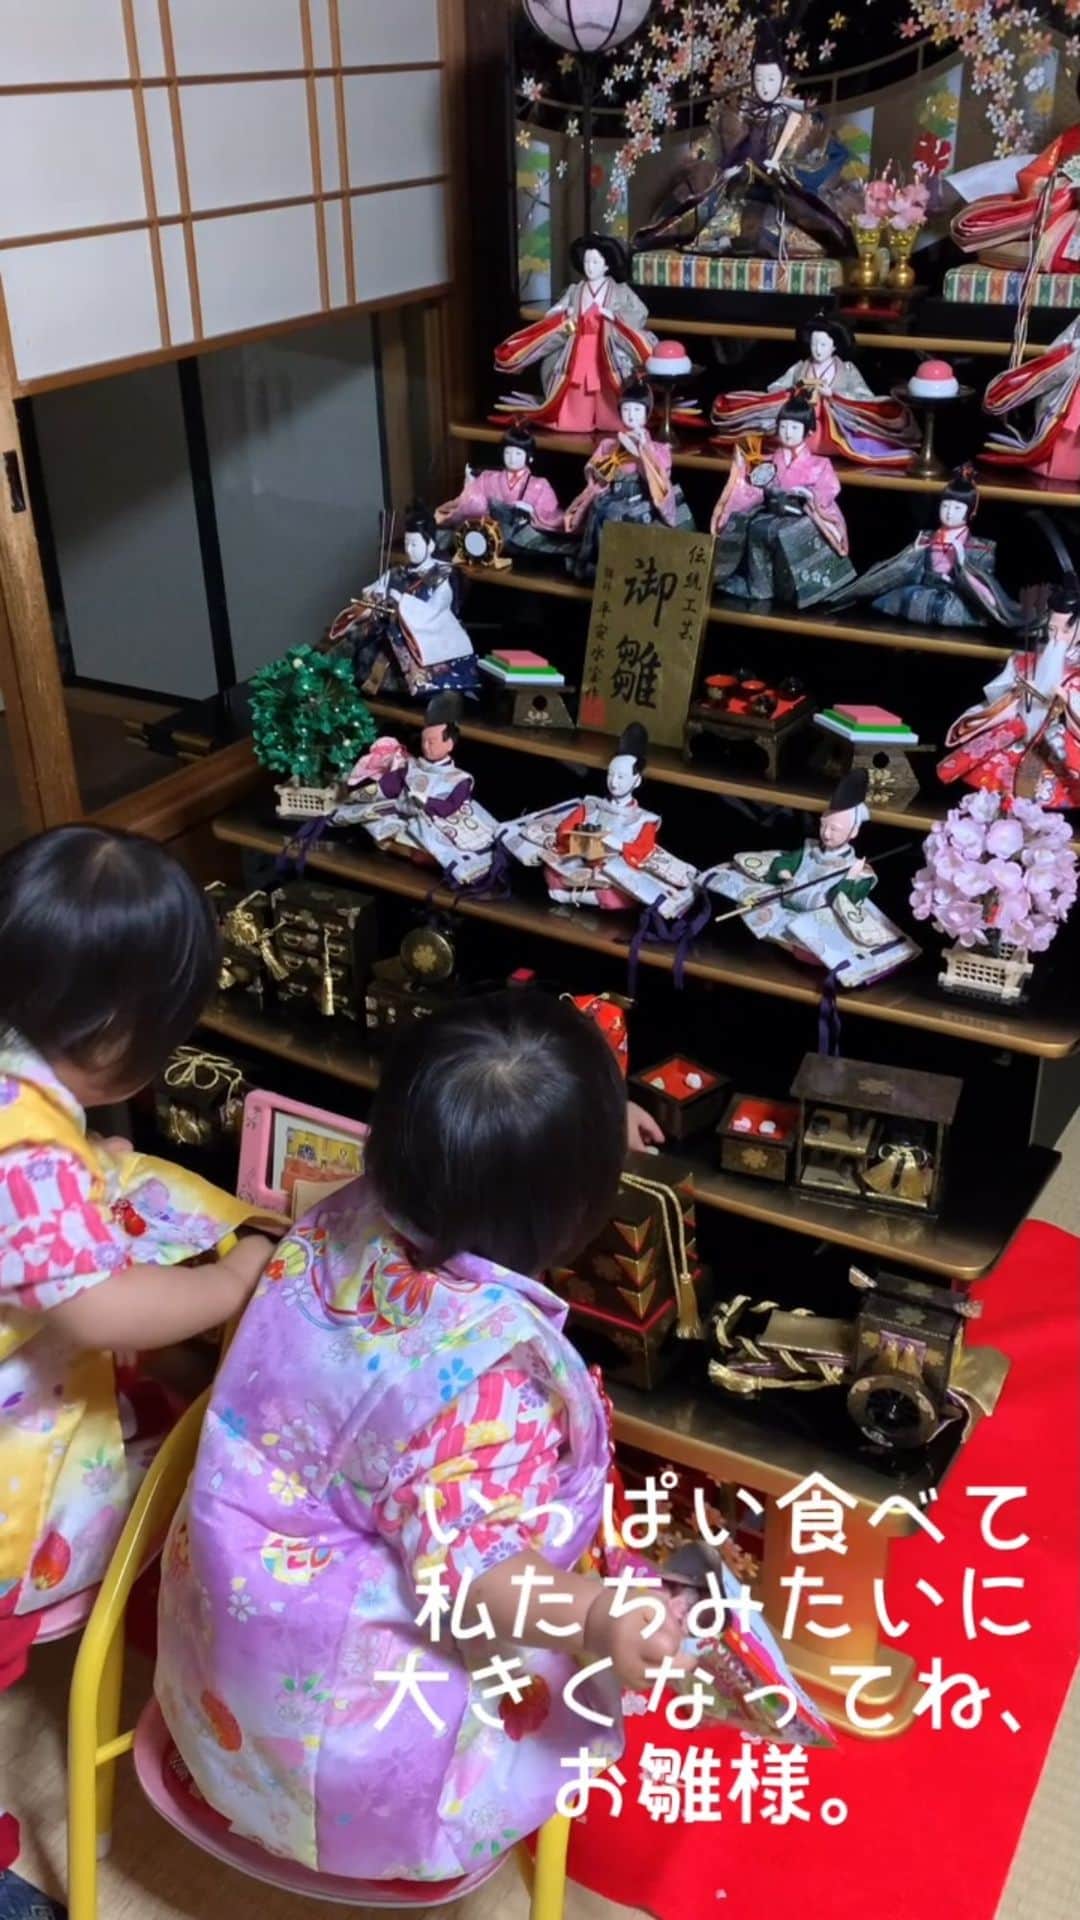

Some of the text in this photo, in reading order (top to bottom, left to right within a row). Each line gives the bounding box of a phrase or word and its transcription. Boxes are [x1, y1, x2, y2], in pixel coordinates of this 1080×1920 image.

[610, 556, 678, 709] 御雛
[678, 545, 706, 641] 伝統工芸
